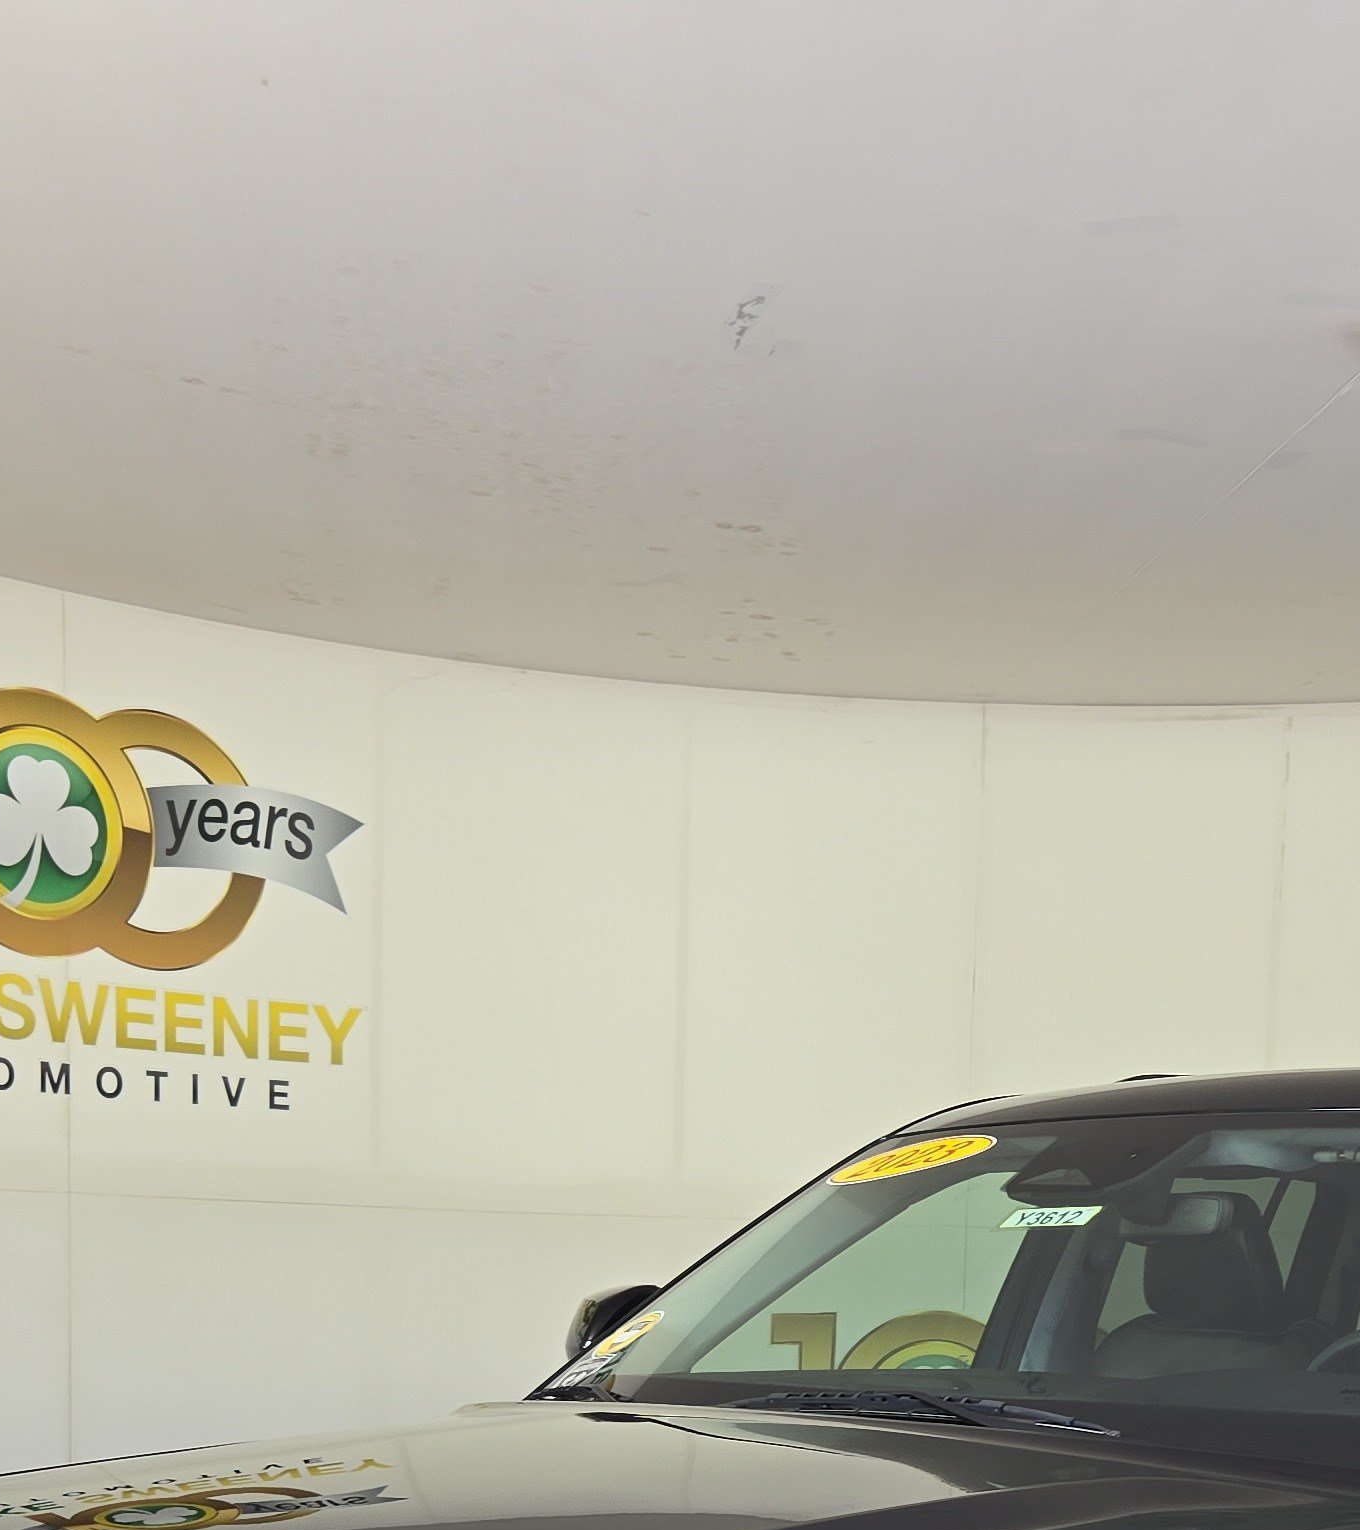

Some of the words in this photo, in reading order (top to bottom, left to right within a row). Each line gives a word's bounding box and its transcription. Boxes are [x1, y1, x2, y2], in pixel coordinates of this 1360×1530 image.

[164, 797, 316, 861] years
[844, 1140, 975, 1180] 2023
[1014, 1210, 1084, 1226] Y3612
